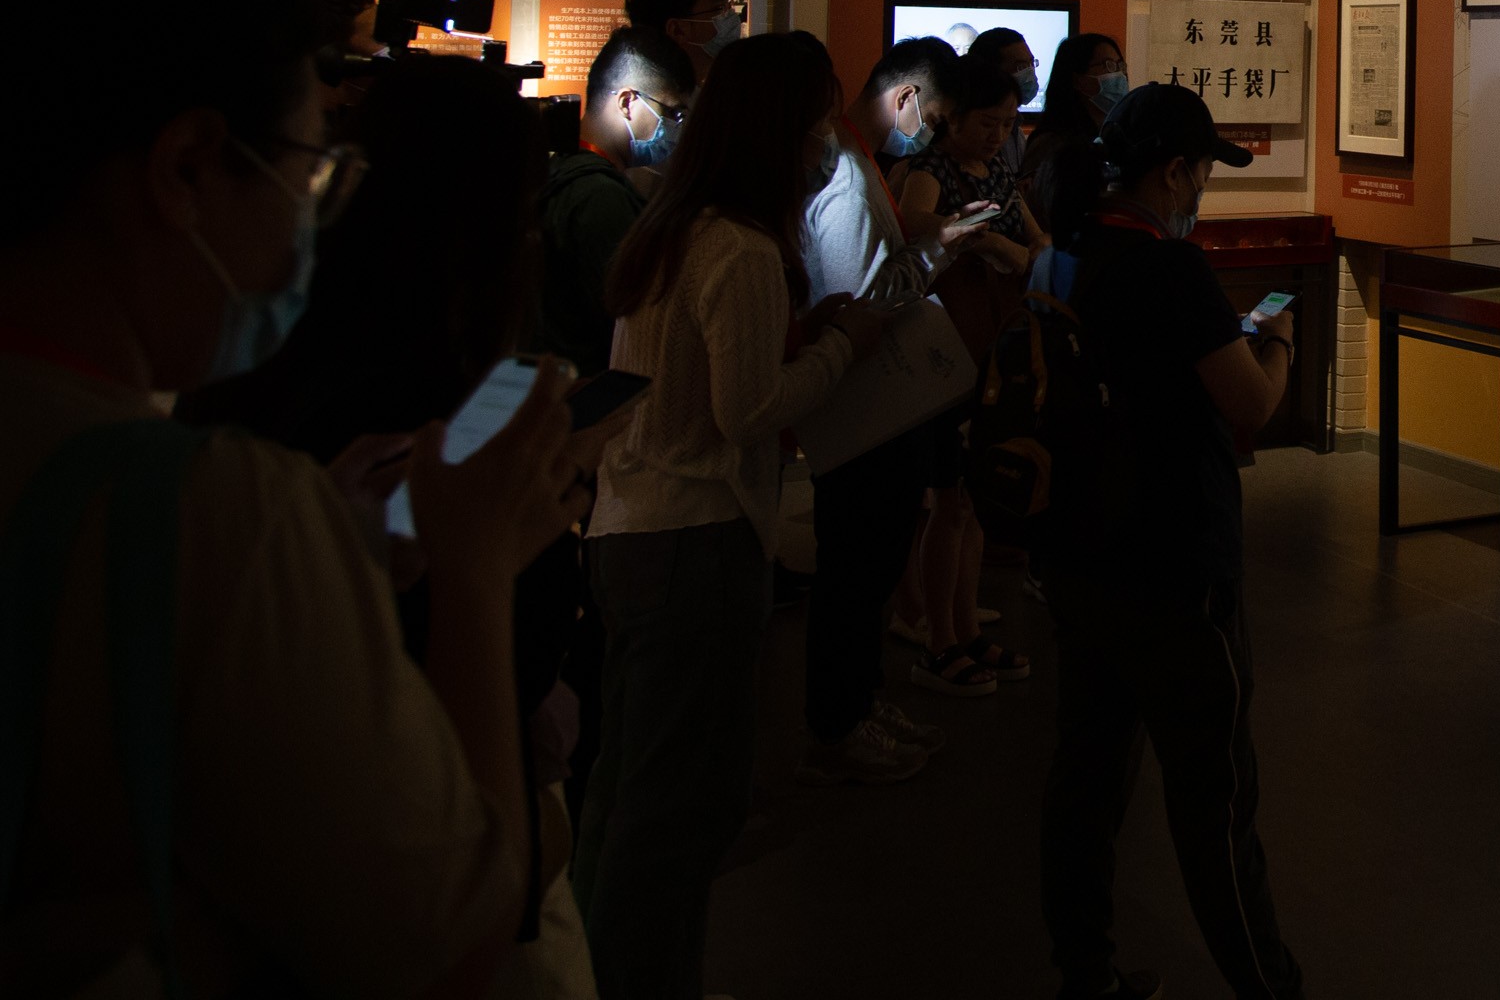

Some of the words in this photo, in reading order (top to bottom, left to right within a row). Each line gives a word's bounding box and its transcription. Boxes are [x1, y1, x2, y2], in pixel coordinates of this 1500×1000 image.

[1185, 18, 1273, 46] 东莞县
[1164, 66, 1290, 99] 太平手袋厂
